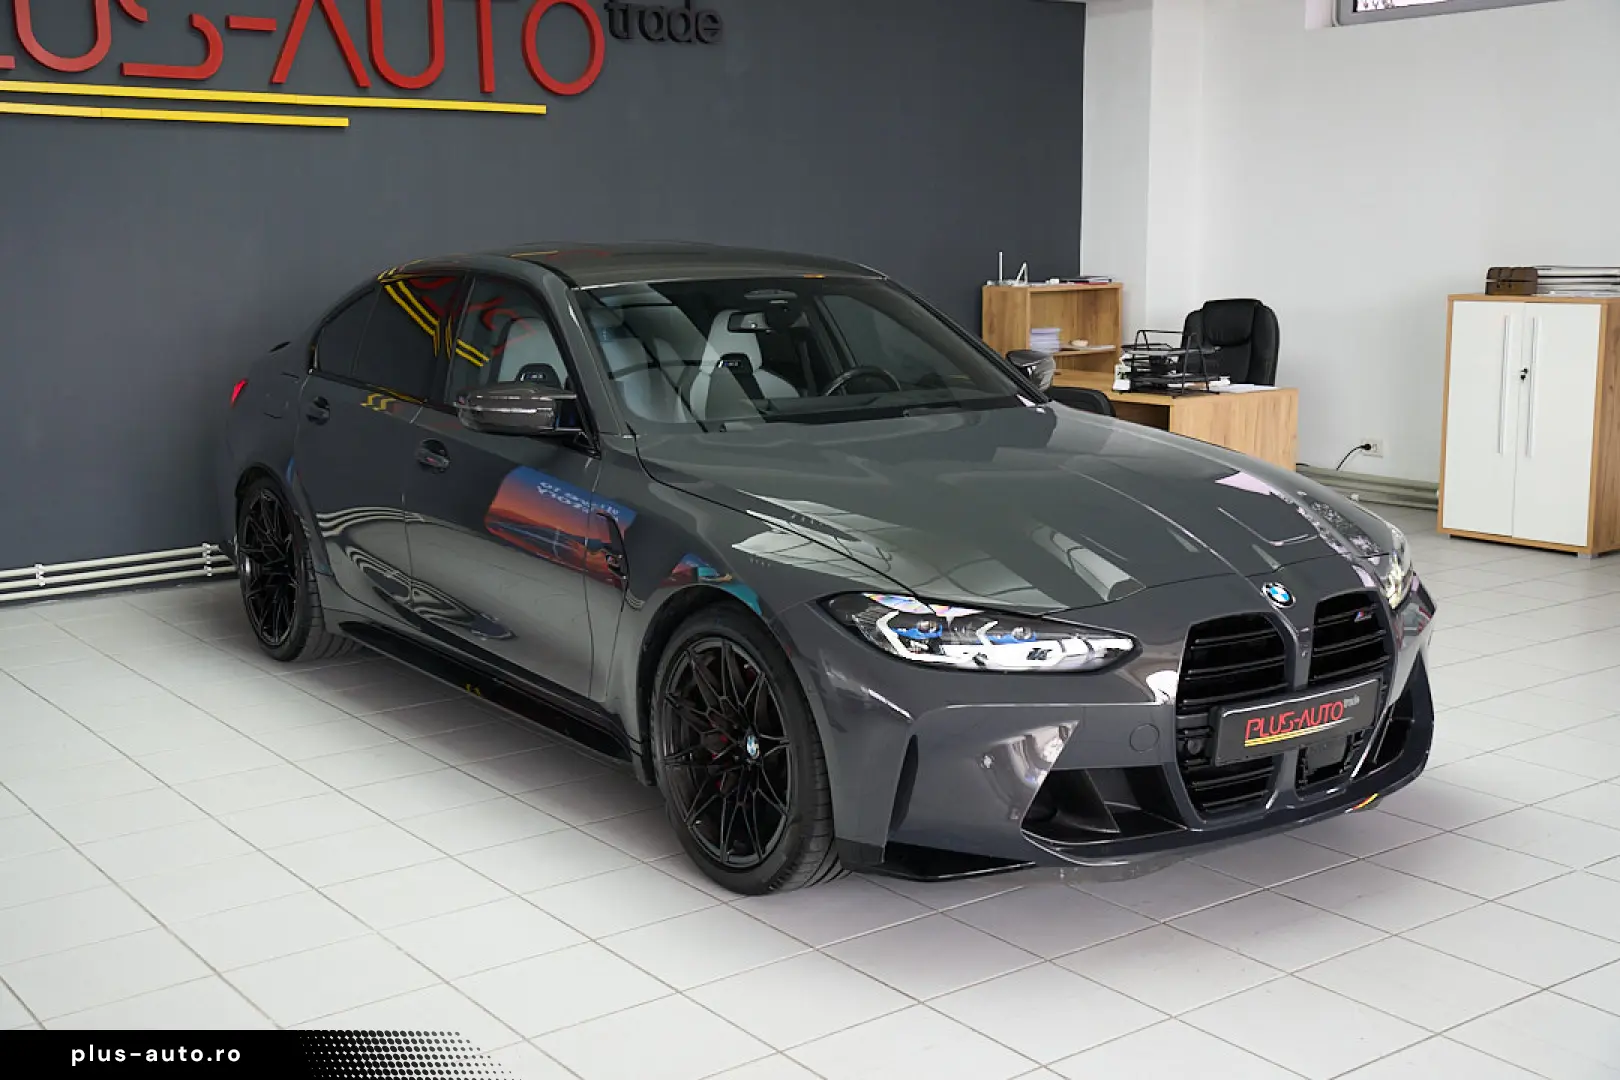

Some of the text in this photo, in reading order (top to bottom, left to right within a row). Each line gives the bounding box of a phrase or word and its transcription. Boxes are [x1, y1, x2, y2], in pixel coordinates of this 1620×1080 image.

[0, 0, 723, 95] US-AUTO trade
[1244, 700, 1344, 741] PLUS-AUTO
